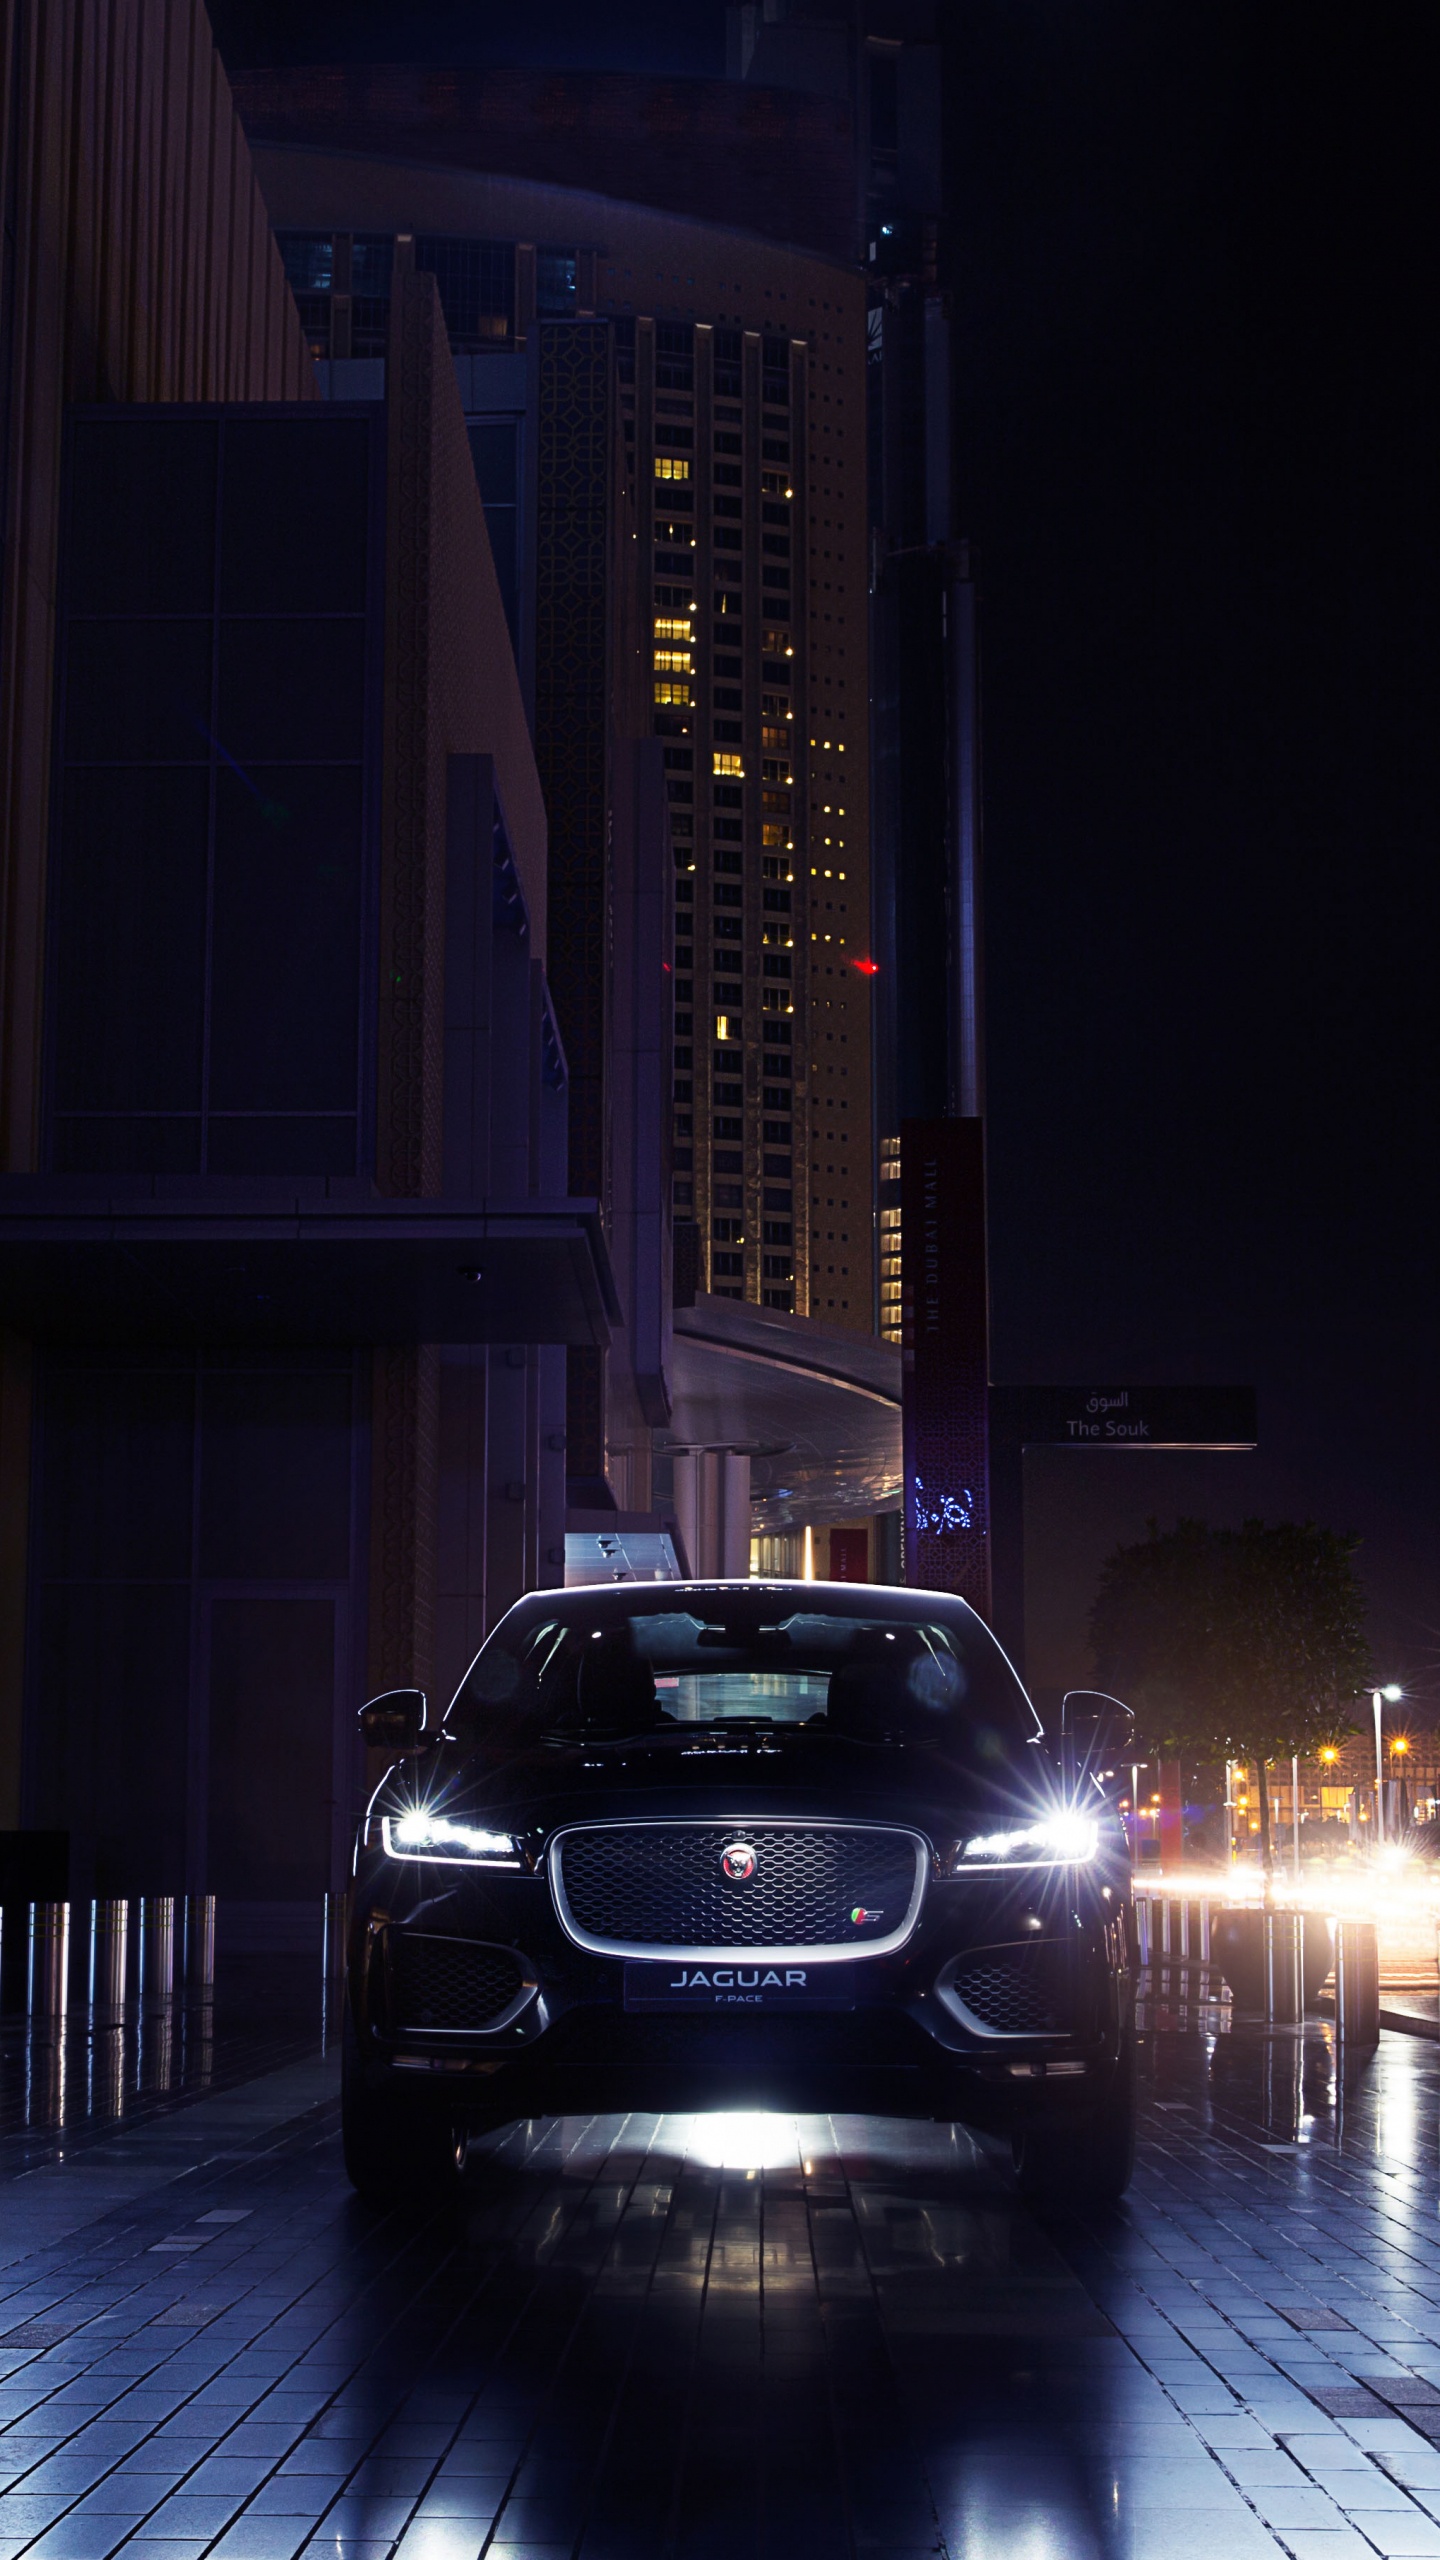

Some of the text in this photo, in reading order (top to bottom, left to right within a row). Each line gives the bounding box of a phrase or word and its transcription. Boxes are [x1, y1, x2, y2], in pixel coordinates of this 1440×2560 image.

[923, 1156, 941, 1333] THE DUBAI MALL
[1085, 1391, 1129, 1414] السوق
[1066, 1419, 1150, 1437] The Souk
[669, 1969, 807, 1988] JAGUAR
[714, 1994, 764, 2004] F-PACE
